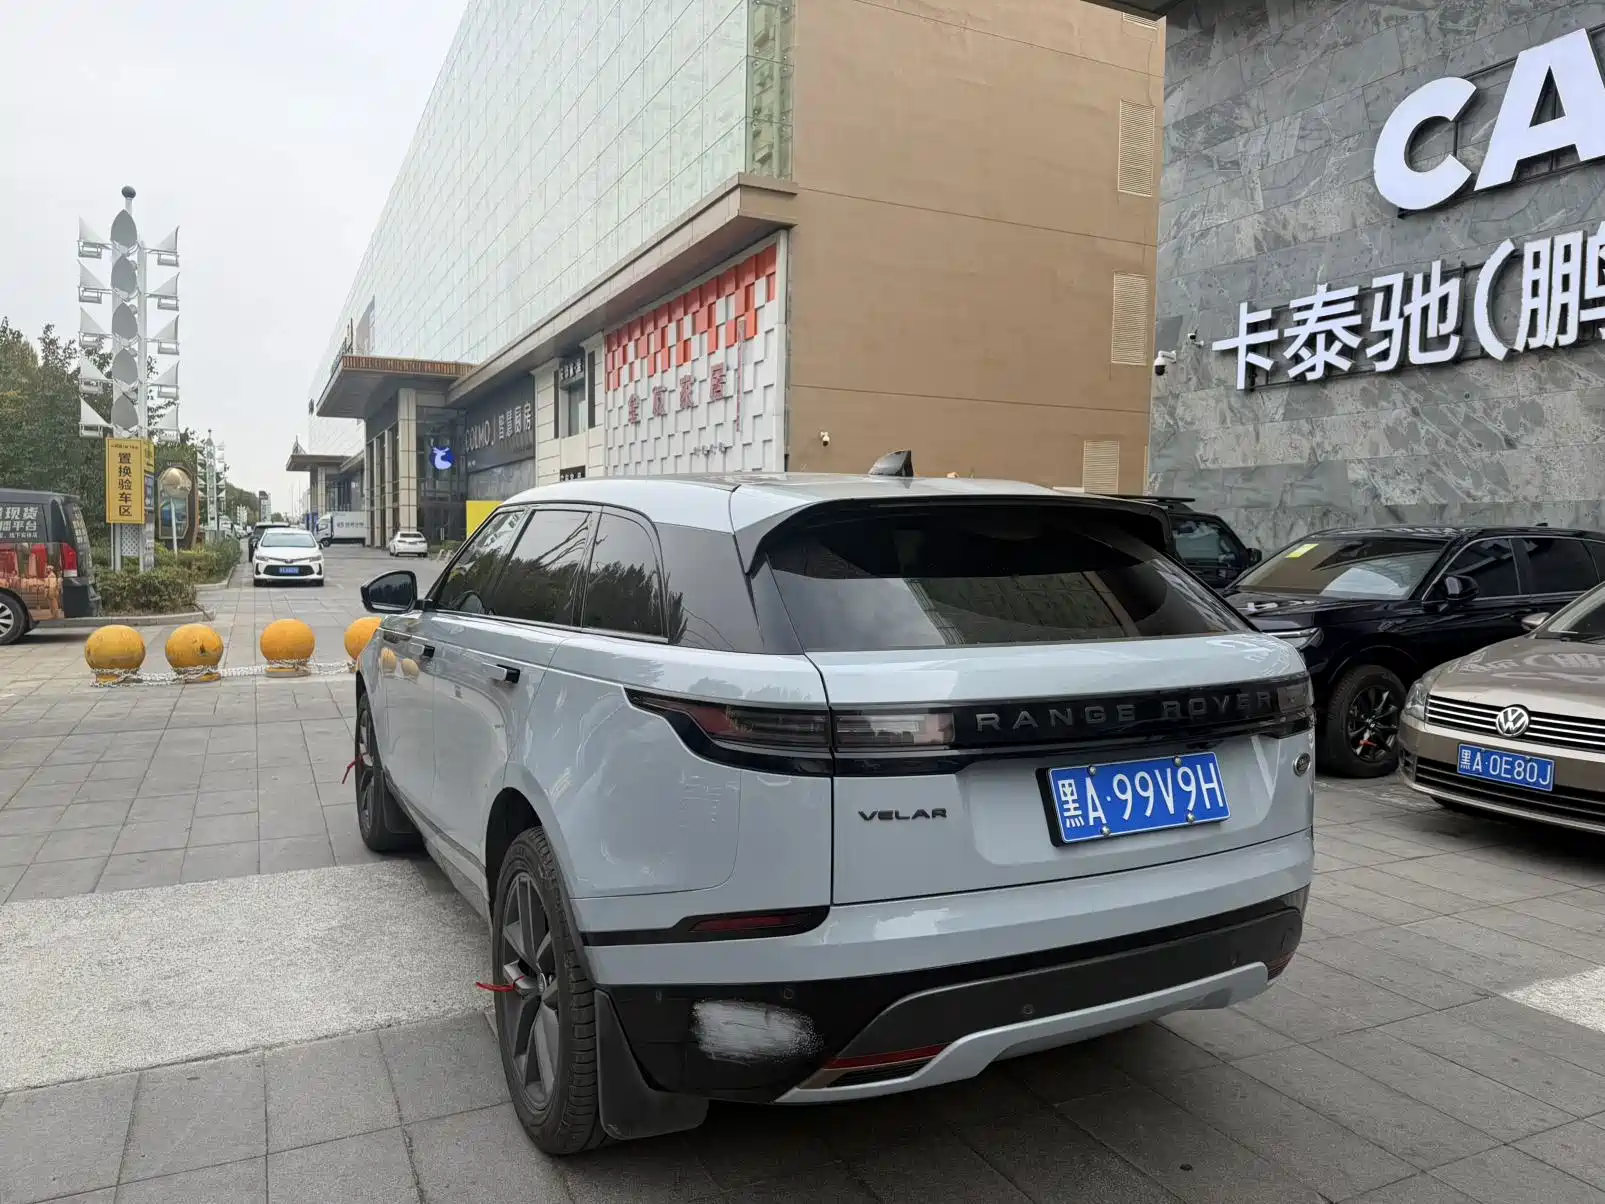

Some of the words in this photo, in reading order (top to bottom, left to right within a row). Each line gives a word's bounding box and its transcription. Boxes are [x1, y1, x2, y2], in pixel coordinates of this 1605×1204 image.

[1373, 28, 1605, 211] CA
[117, 452, 133, 517] 置换验车区
[975, 704, 1137, 732] RANGE
[1161, 691, 1272, 720] ROVER
[857, 806, 948, 822] VELAR
